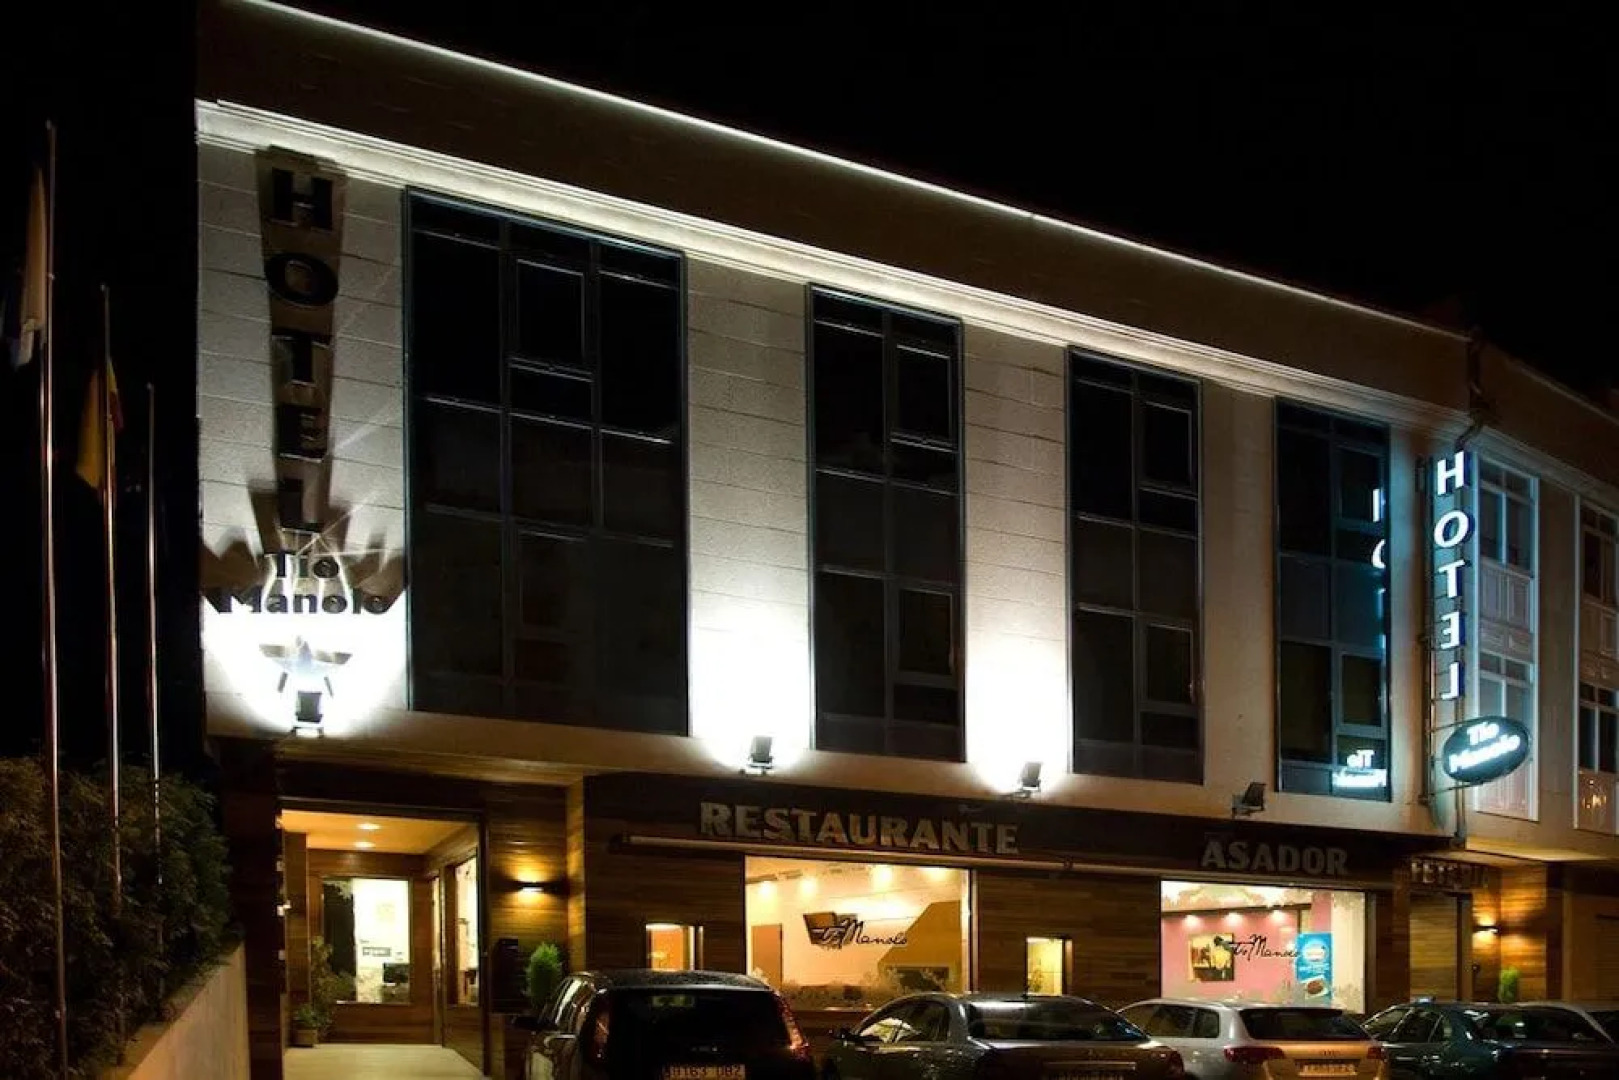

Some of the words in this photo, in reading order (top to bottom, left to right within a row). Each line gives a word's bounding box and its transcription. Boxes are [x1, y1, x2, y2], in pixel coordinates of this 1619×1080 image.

[265, 166, 339, 529] HOTEL
[215, 586, 391, 614] Manolo
[700, 801, 1019, 855] RESTAURANTE
[1201, 840, 1349, 875] ASADOR
